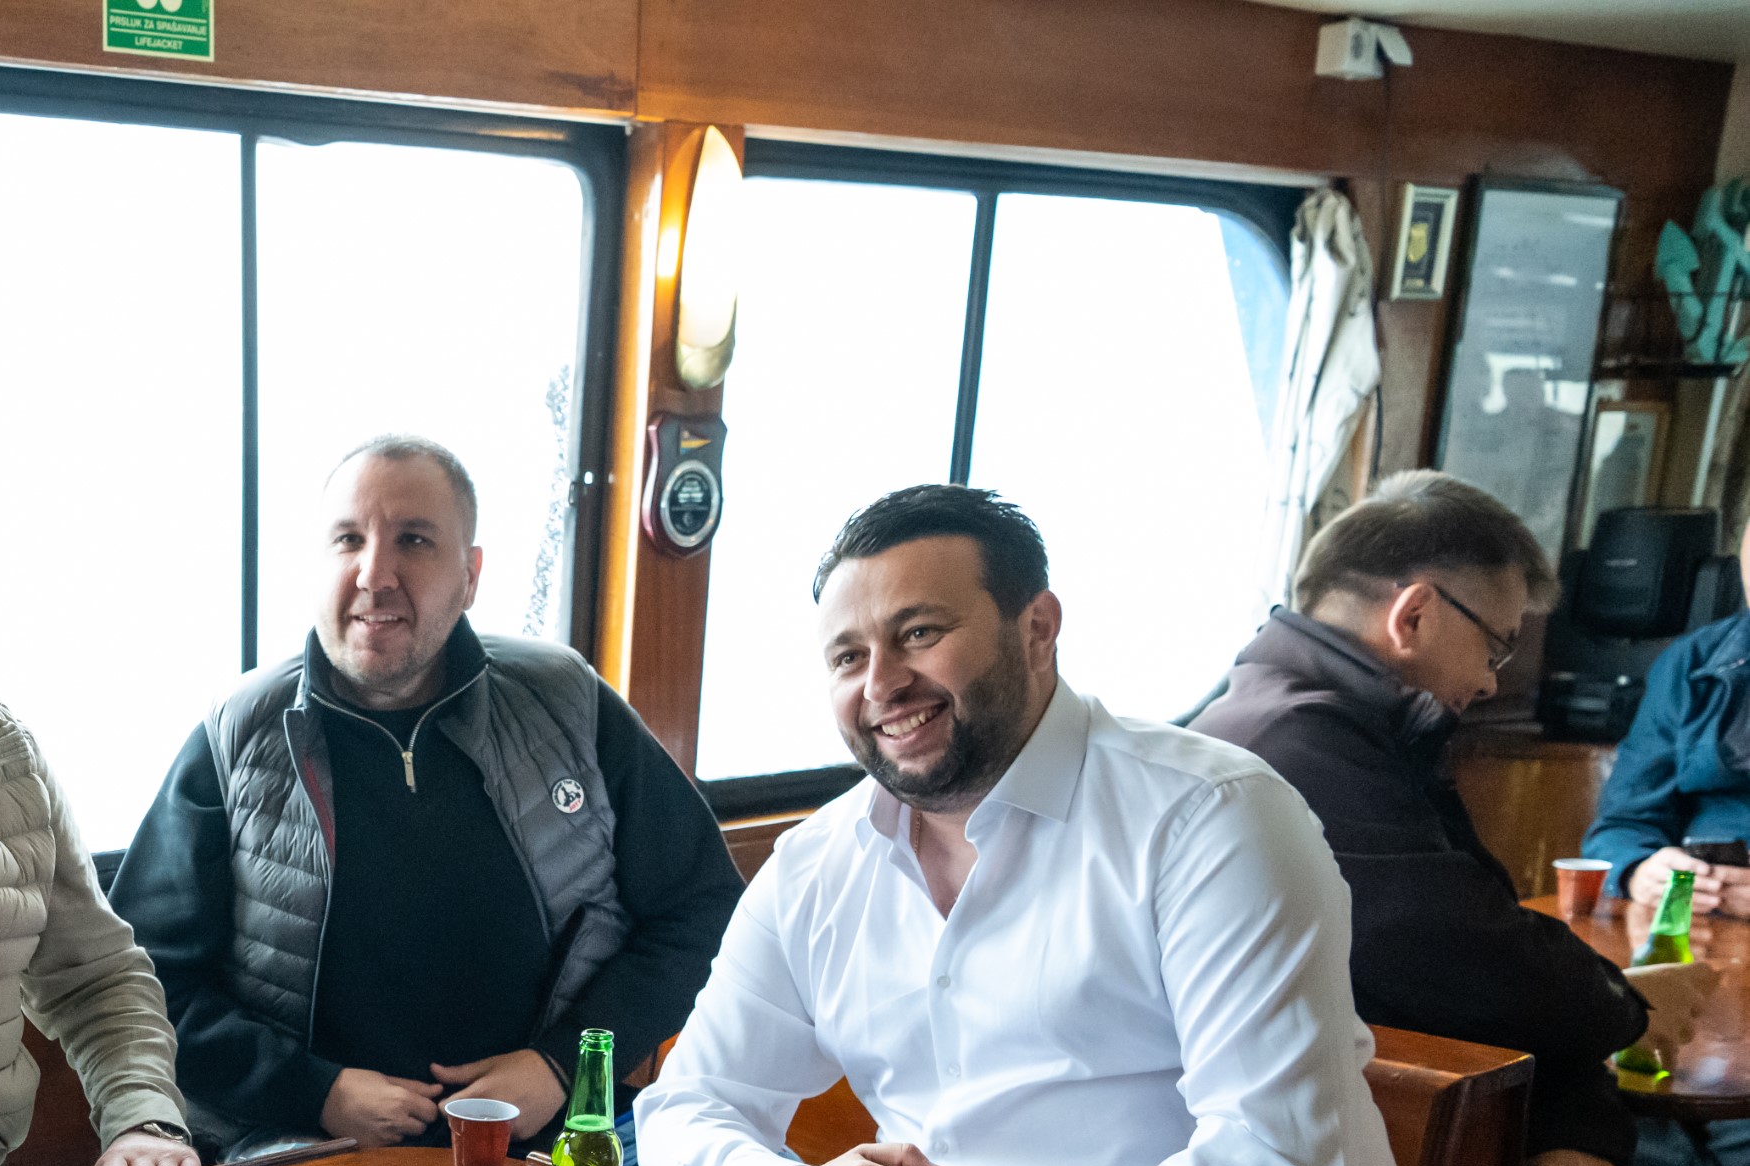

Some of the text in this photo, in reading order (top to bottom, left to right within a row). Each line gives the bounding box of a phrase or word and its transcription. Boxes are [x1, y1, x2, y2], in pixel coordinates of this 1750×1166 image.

[109, 15, 207, 35] PRSLUK ZA SPAŠAVANJE
[134, 36, 184, 50] LIFEJACKET
